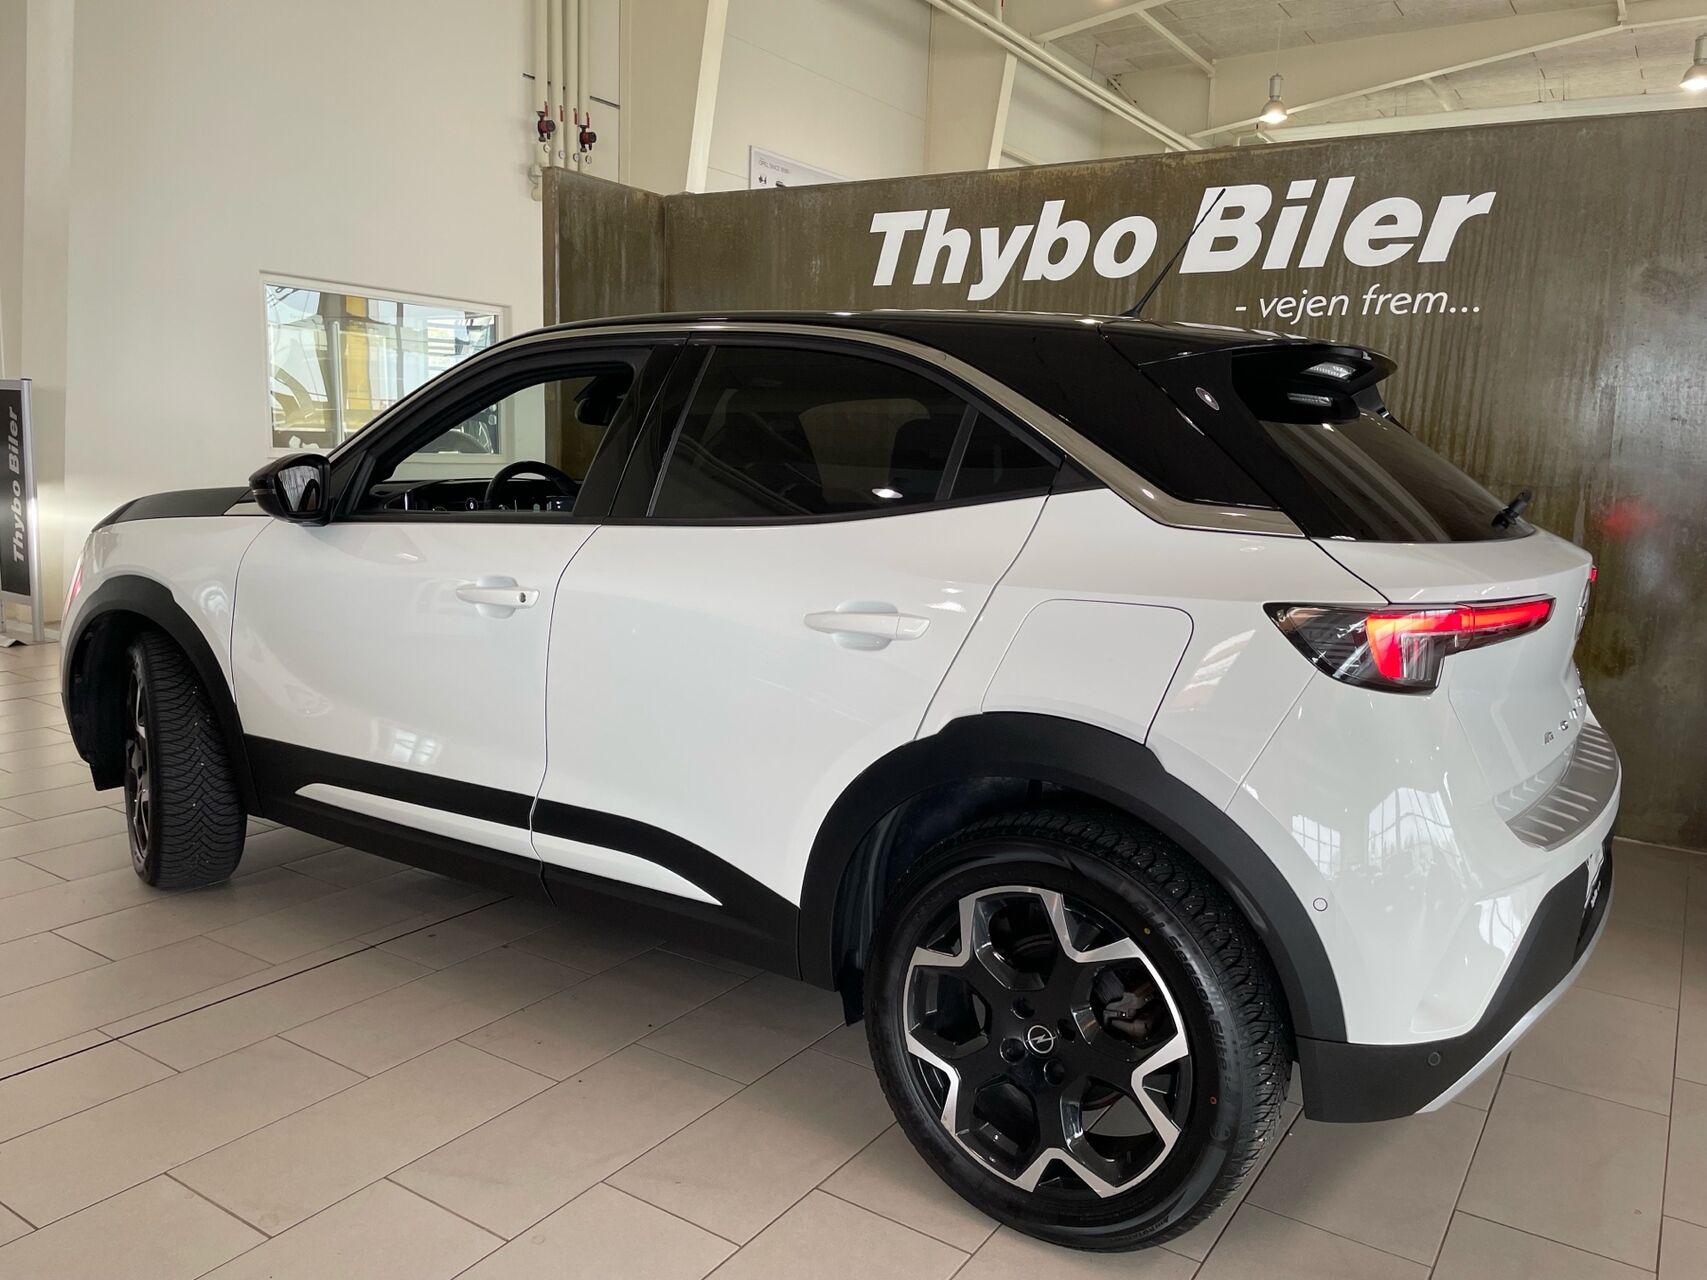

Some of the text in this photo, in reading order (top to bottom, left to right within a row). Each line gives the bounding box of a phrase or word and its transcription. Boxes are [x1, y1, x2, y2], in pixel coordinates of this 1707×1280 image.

[870, 176, 1496, 301] Thybo Biler
[1259, 289, 1350, 325] vejen
[1362, 283, 1480, 316] frem...
[8, 406, 25, 563] Thybo Biler
